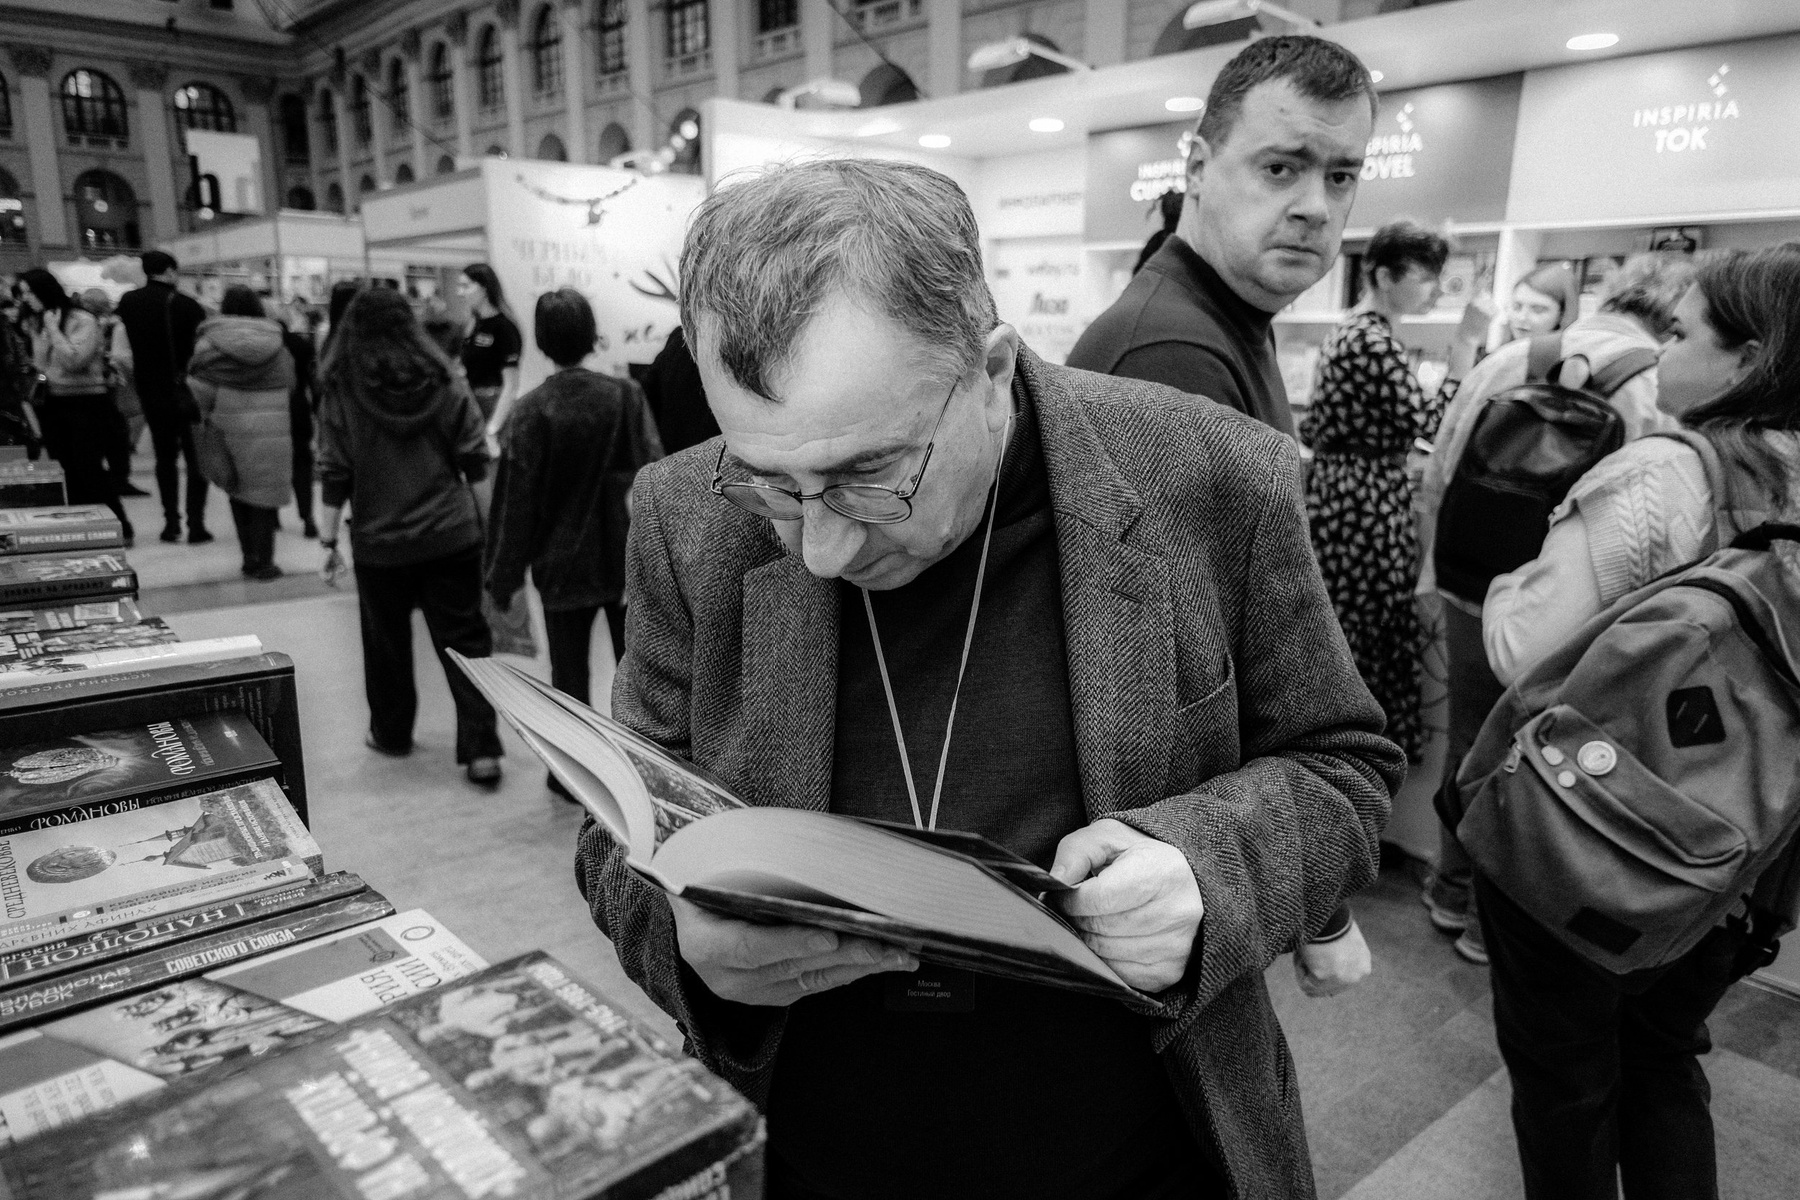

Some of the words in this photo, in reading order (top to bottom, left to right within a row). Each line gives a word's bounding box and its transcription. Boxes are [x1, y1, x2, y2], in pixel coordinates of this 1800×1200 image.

[1633, 100, 1740, 128] INSPIRIA
[1365, 133, 1423, 156] SPIRIA
[1360, 154, 1416, 180] OVEL
[79, 672, 152, 687] ИСТОРИЯ
[146, 720, 197, 776] РОМАНОВЫ
[0, 824, 22, 836] ЕНКО
[30, 798, 141, 831] РОМАНОВЫ
[0, 840, 27, 919] СРЕДНЕВЕКОВЬЕ
[85, 904, 157, 929] АФИНАХ
[22, 909, 228, 972] НАПОЛЕОН
[166, 941, 249, 974] СОВЕТСКОГО
[249, 928, 297, 952] СОЮЗА
[0, 965, 132, 1009] ВЛАДИСЛАВ
[361, 969, 407, 1004] РИЯ
[396, 957, 441, 989] СИИ
[917, 979, 941, 988] Москва
[0, 988, 74, 1016] ЗУБОК
